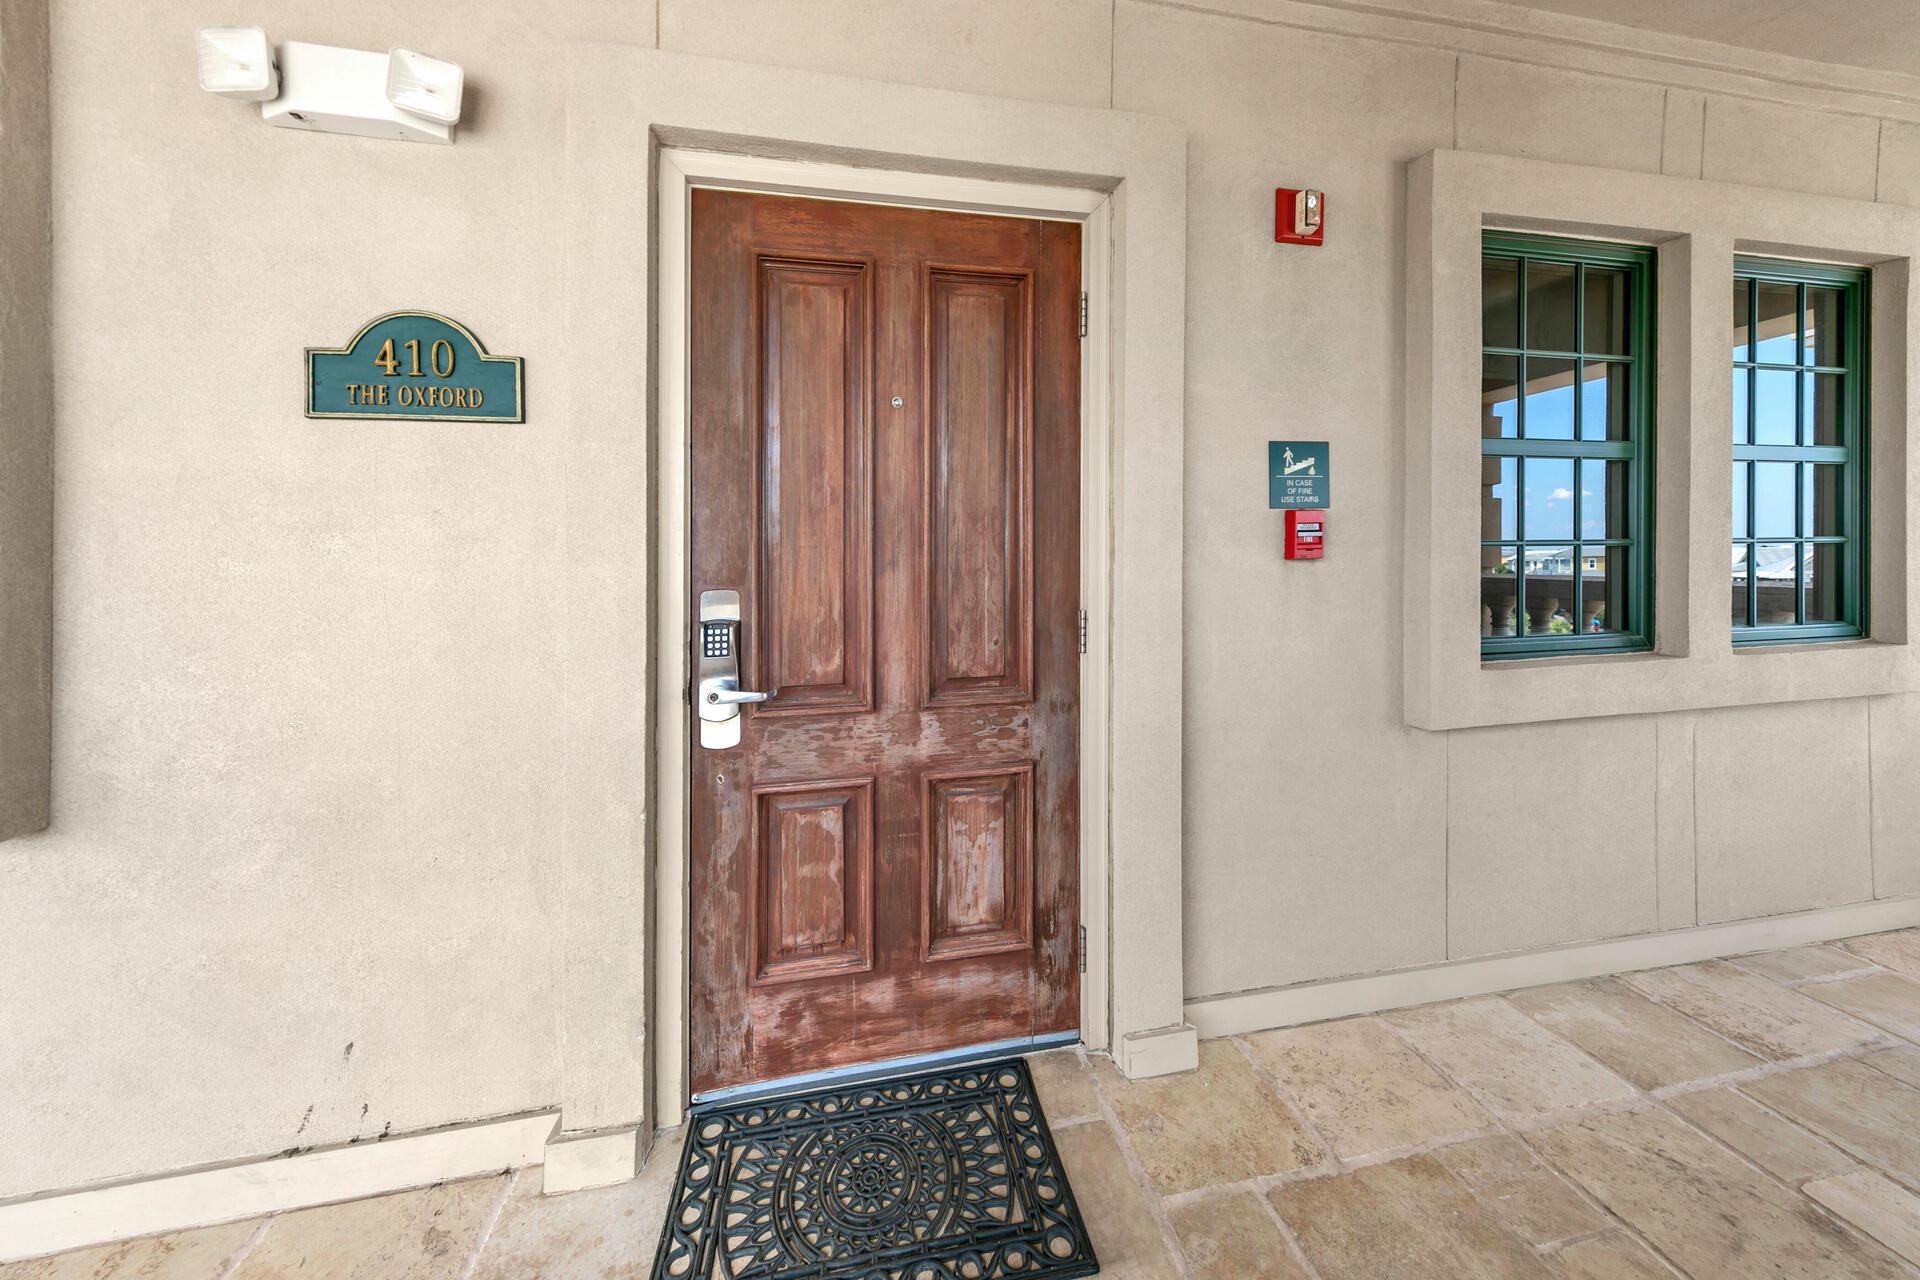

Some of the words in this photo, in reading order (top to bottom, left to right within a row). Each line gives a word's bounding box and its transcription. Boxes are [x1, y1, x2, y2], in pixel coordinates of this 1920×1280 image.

[374, 338, 456, 378] 410
[346, 385, 390, 406] THE
[397, 385, 484, 408] OXFORD
